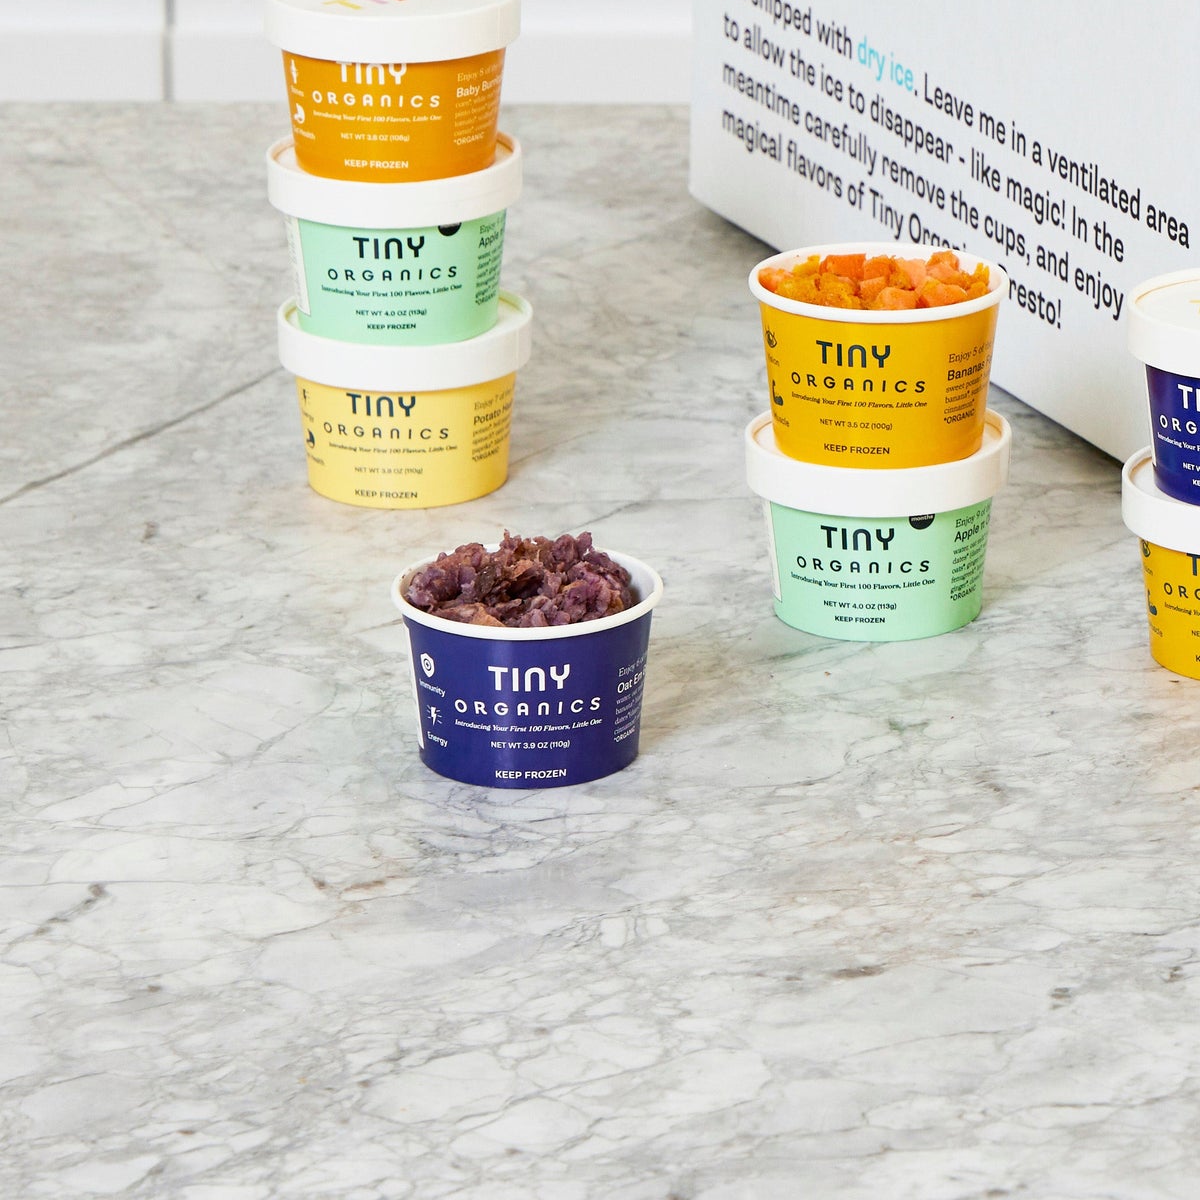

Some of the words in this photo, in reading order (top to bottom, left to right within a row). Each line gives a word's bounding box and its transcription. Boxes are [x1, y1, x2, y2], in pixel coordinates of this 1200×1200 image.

[336, 61, 407, 86] TINY
[312, 91, 440, 108] ORGANICS
[456, 84, 480, 98] Baby
[724, 13, 739, 42] to
[744, 23, 785, 69] allow
[790, 49, 815, 87] the
[821, 64, 843, 102] ice
[849, 83, 865, 114] to
[871, 94, 953, 164] disappear
[971, 148, 1000, 192] like
[1007, 175, 1065, 230] magic!
[1072, 206, 1087, 244] In
[1094, 221, 1124, 263] the
[817, 19, 852, 60] with
[857, 34, 885, 82] dry
[890, 51, 918, 97] ice.
[924, 73, 973, 127] Leave
[980, 110, 1005, 145] me
[1012, 121, 1026, 157] in
[1033, 141, 1042, 166] a
[1048, 148, 1140, 221] ventilated
[1147, 204, 1190, 249] area
[344, 158, 368, 168] KEEP
[370, 160, 409, 169] FROZEN
[722, 110, 782, 162] magical
[787, 140, 842, 198] flavors
[848, 182, 865, 210] of
[869, 188, 903, 240] Tiny
[723, 63, 800, 126] meantime
[805, 111, 876, 177] carefully
[883, 154, 945, 211] remove
[951, 189, 978, 229] the
[984, 215, 1030, 266] cups,
[1036, 245, 1068, 284] and
[1075, 267, 1124, 321] enjoy
[353, 236, 425, 259] TINY
[479, 233, 499, 248] Apple
[327, 266, 458, 282] ORGANICS
[998, 263, 1061, 329] resto!
[816, 340, 891, 368] TINY
[947, 361, 984, 381] Bananas
[791, 372, 926, 393] ORGANICS
[346, 392, 416, 417] TINY
[474, 409, 500, 425] Potato
[820, 418, 833, 426] NET
[859, 421, 870, 429] OZ
[871, 422, 892, 430] (100g)
[323, 423, 449, 439] ORGANICS
[824, 443, 848, 452] KEEP
[850, 445, 891, 455] FROZEN
[379, 491, 418, 499] FROZEN
[820, 524, 895, 551] TINY
[954, 525, 979, 543] Apple
[796, 556, 930, 574] ORGANICS
[835, 615, 854, 624] KEEP
[855, 616, 885, 624] FROZEN
[488, 663, 570, 692] TINY
[419, 679, 446, 697] Immunity
[617, 680, 633, 694] Oat
[454, 697, 601, 716] ORGANICS
[455, 719, 491, 732] Introducing
[492, 724, 508, 732] Your
[509, 725, 527, 733] First
[543, 723, 570, 732] Flavors,
[572, 719, 589, 729] Little
[590, 718, 603, 726] One
[427, 732, 448, 747] Energy
[491, 741, 506, 749] NET
[537, 741, 548, 749] OZ
[550, 740, 570, 750] (110g)
[495, 770, 522, 779] KEEP
[524, 769, 567, 779] FROZEN
